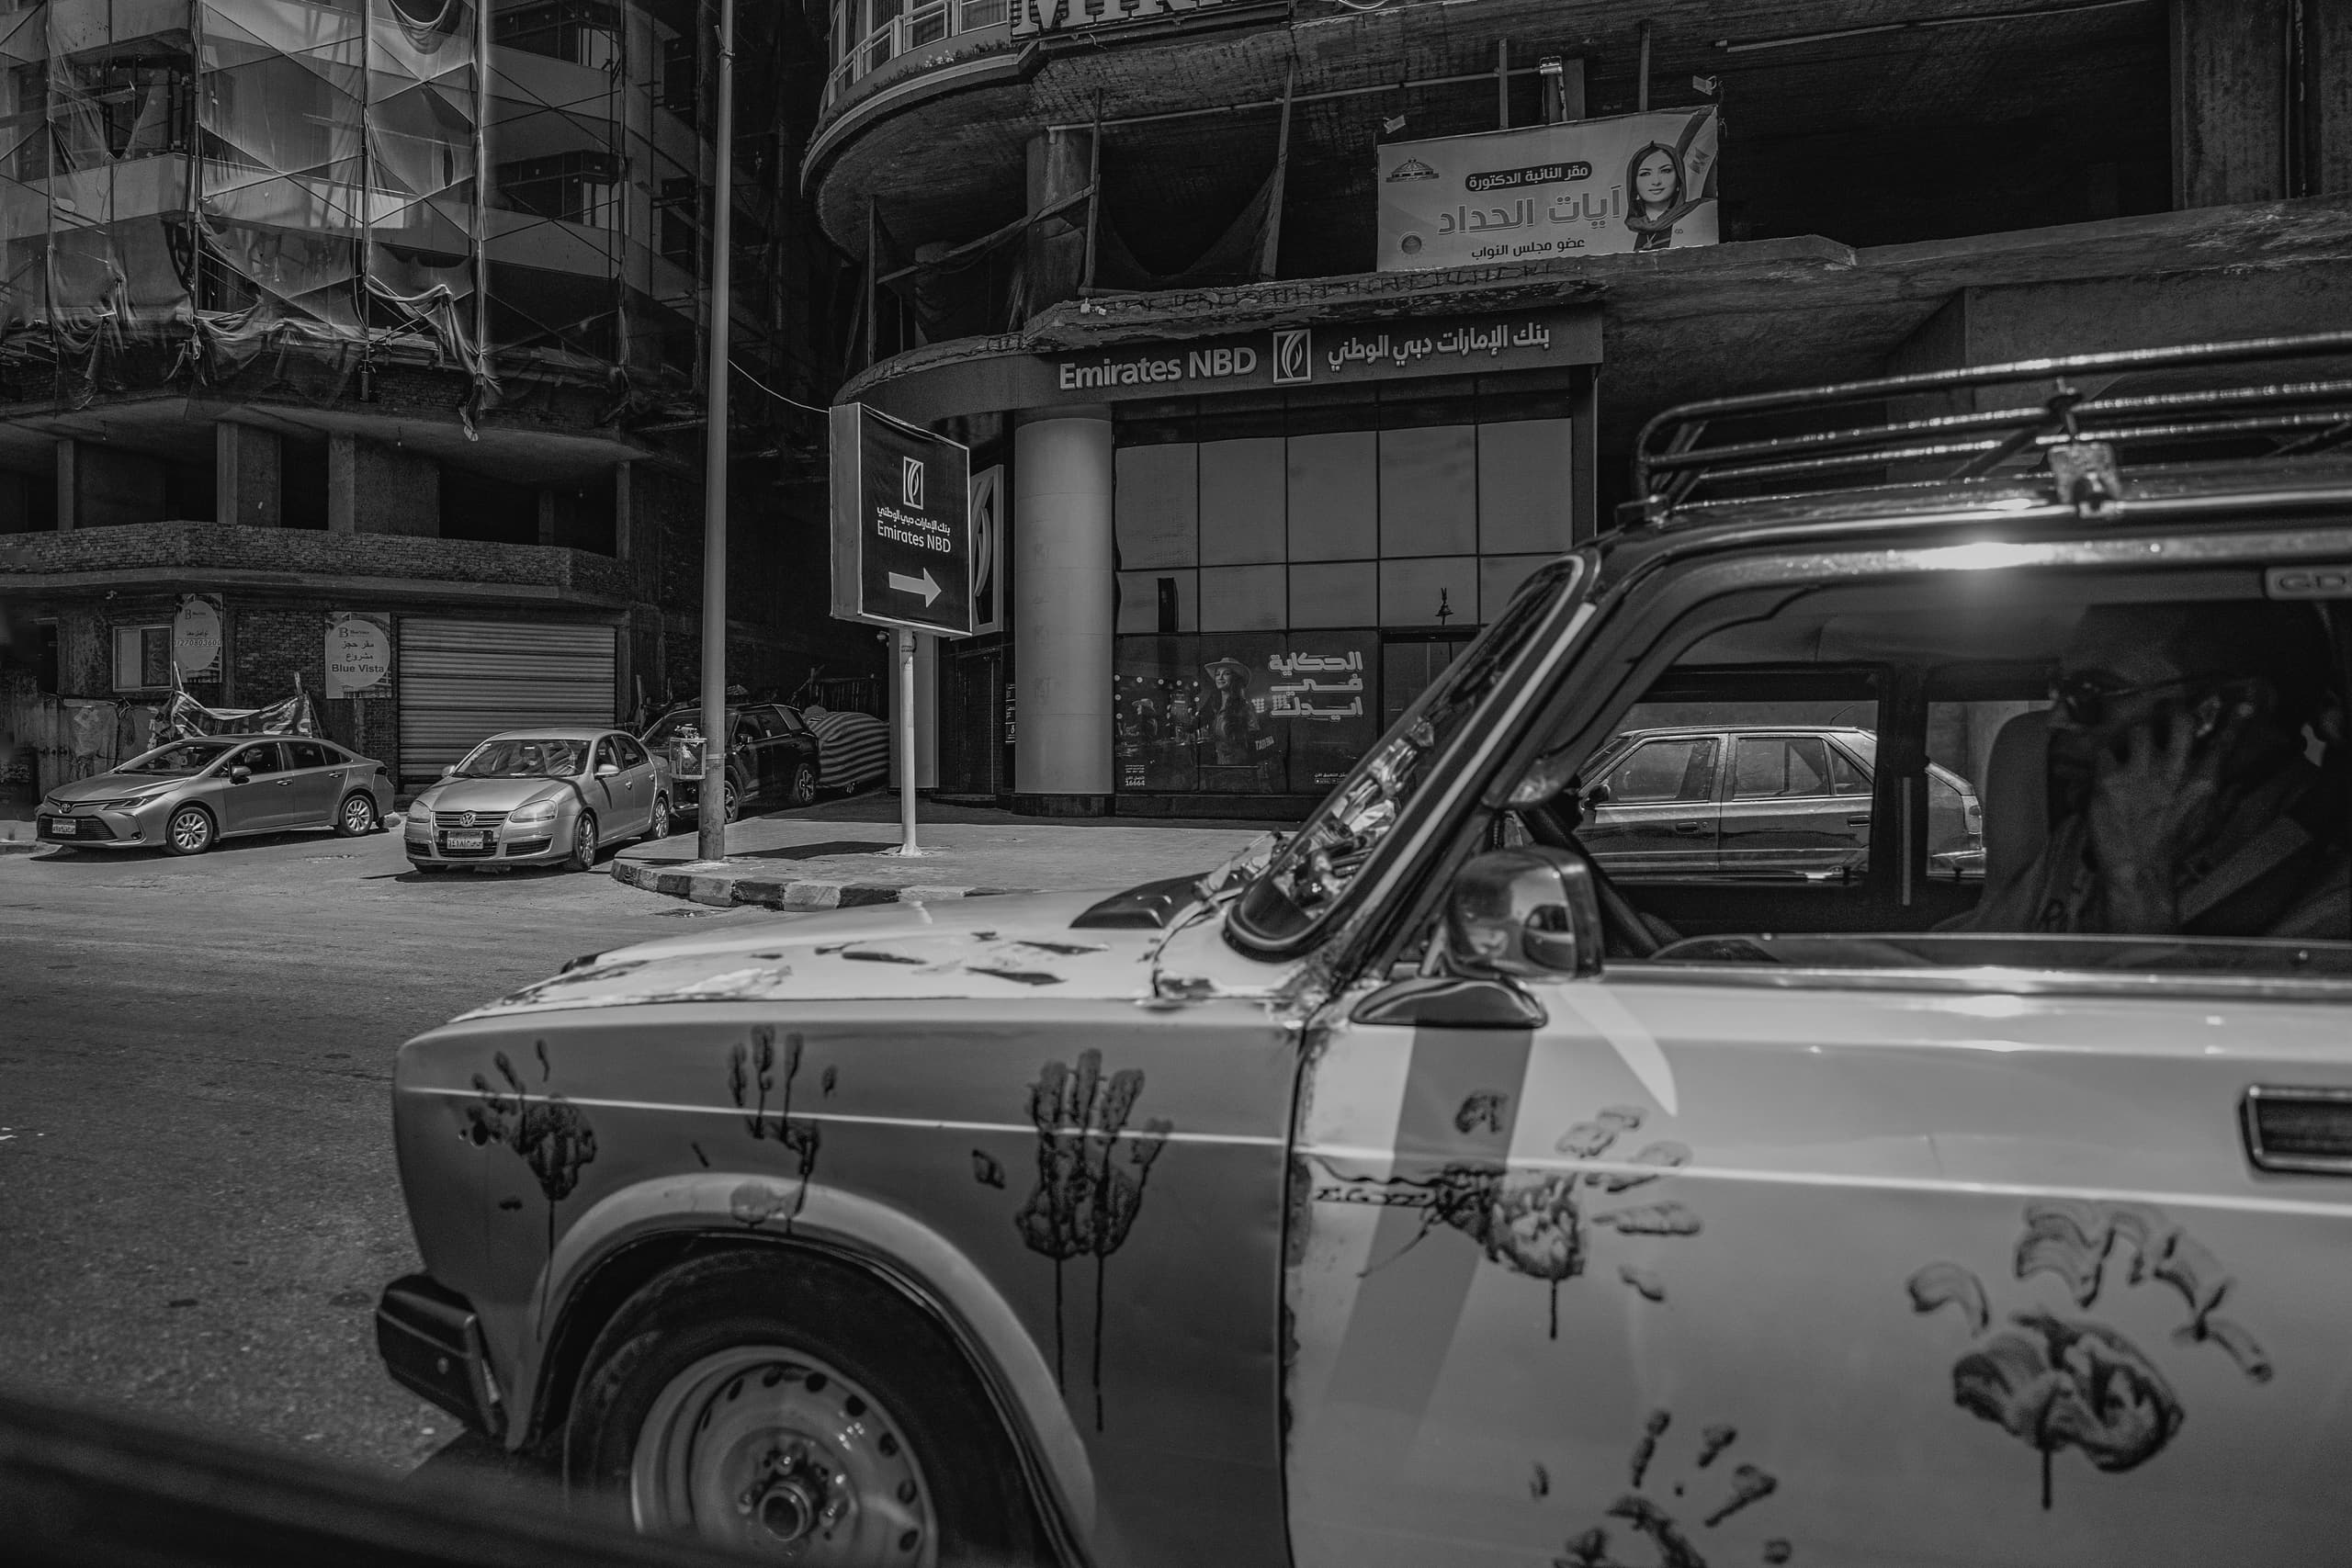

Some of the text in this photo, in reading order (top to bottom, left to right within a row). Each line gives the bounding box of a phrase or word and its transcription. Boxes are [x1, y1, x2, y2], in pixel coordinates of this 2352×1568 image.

[1468, 165, 1589, 191] مقر النائبة الدكتورة
[1437, 197, 1535, 235] الحداد
[1471, 237, 1586, 261] عضو مجلس النواب
[1327, 321, 1550, 372] بنك الإمارات دبي الوطني
[1059, 346, 1258, 390] Emirates NBD
[876, 506, 900, 523] الوطني
[877, 520, 952, 553] Emirates NBD
[937, 522, 951, 536] بنك
[345, 652, 374, 662] مشروع
[360, 640, 375, 649] مقر
[331, 663, 384, 672] Blue Vista
[1268, 650, 1363, 677] الحكاية
